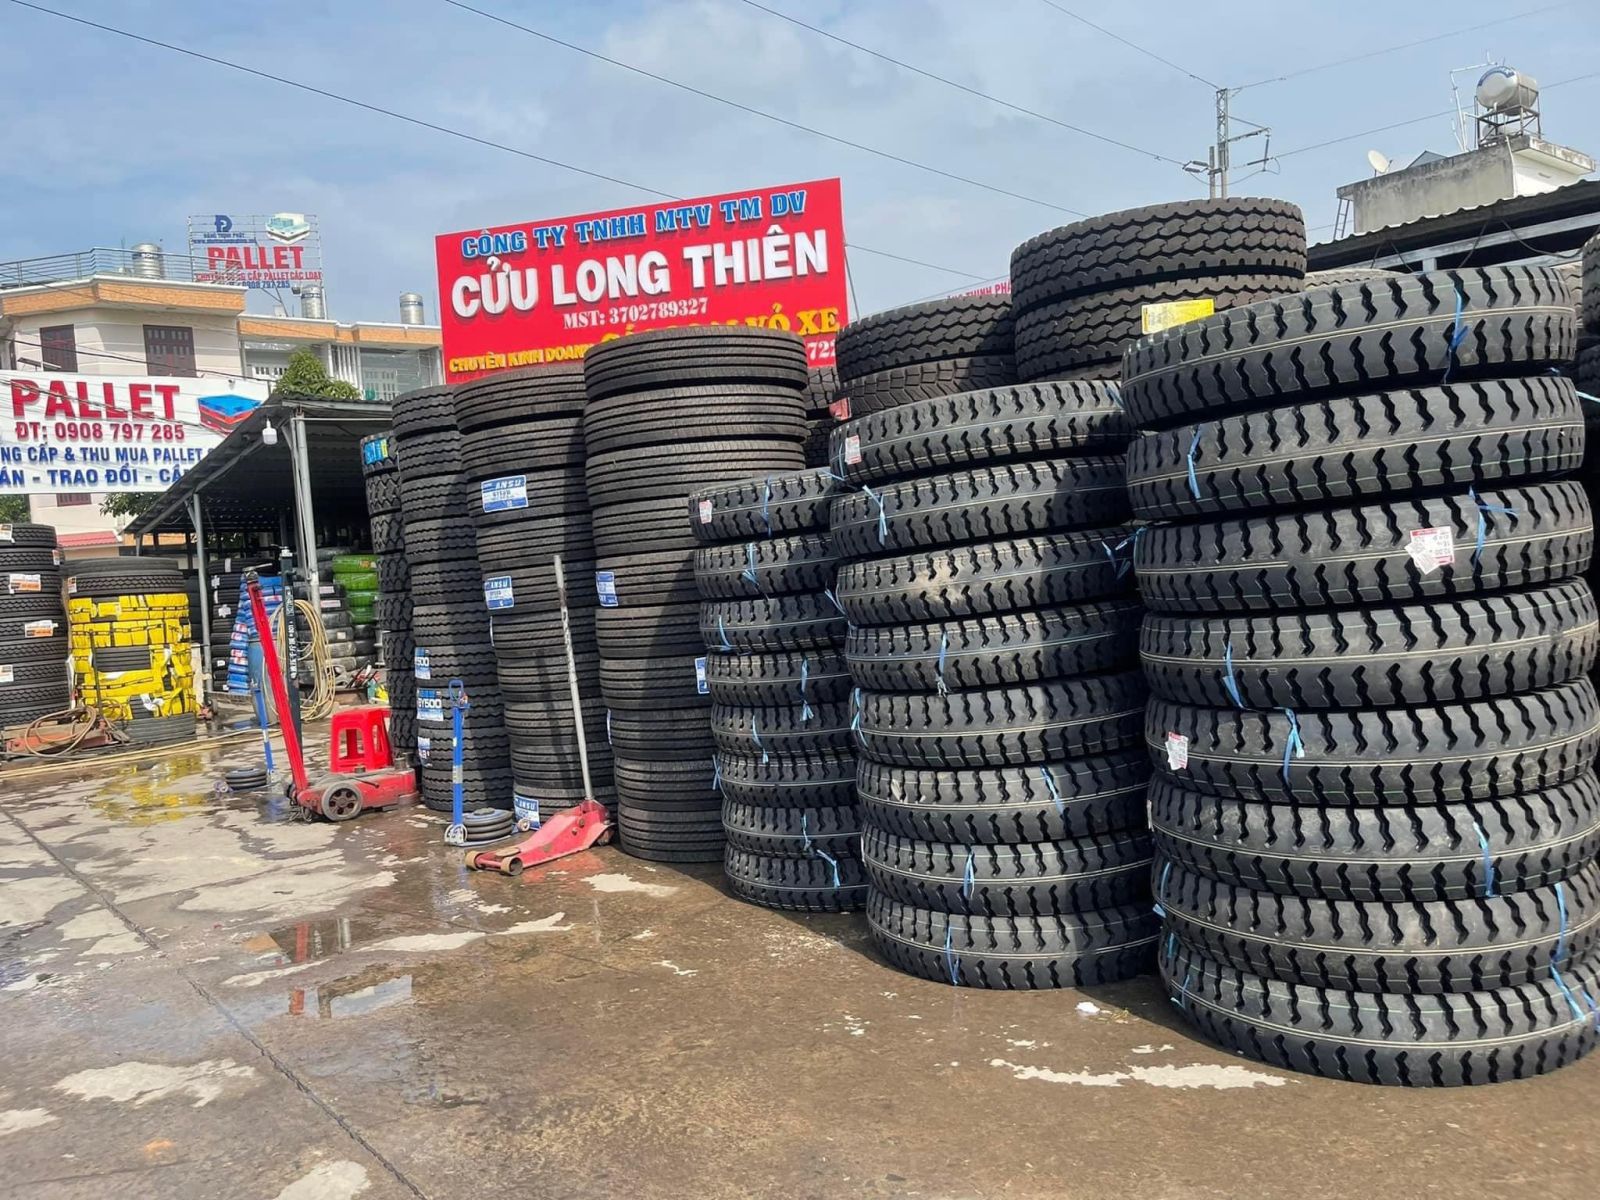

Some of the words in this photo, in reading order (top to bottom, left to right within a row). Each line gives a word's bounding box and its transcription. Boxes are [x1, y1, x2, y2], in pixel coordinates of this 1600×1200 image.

[462, 228, 528, 259] CÔNG
[533, 224, 566, 250] TY
[575, 214, 645, 243] TNHH
[655, 205, 711, 233] MTV
[720, 197, 762, 224] TM
[771, 191, 806, 216] DV
[207, 246, 304, 270] PALLET
[451, 256, 538, 318] CỬU
[552, 251, 671, 306] LONG
[683, 225, 828, 288] THIÊN
[563, 309, 606, 329] MST:
[609, 298, 709, 323] 3702789327
[797, 308, 840, 335] XE
[449, 350, 507, 373] CHUYÊN
[508, 349, 545, 367] KINH
[546, 343, 594, 363] DOAN
[10, 379, 180, 420] PALLET
[15, 422, 47, 439] ĐT:
[55, 422, 103, 440] 0908
[110, 423, 144, 440] 797
[151, 424, 185, 441] 285
[28, 441, 58, 462] CẤP
[64, 448, 75, 461] &
[80, 447, 110, 462] THU
[116, 447, 148, 462] MUA
[154, 448, 202, 462] PALLET
[47, 469, 98, 486] TRAO
[105, 462, 138, 484] ĐỔI
